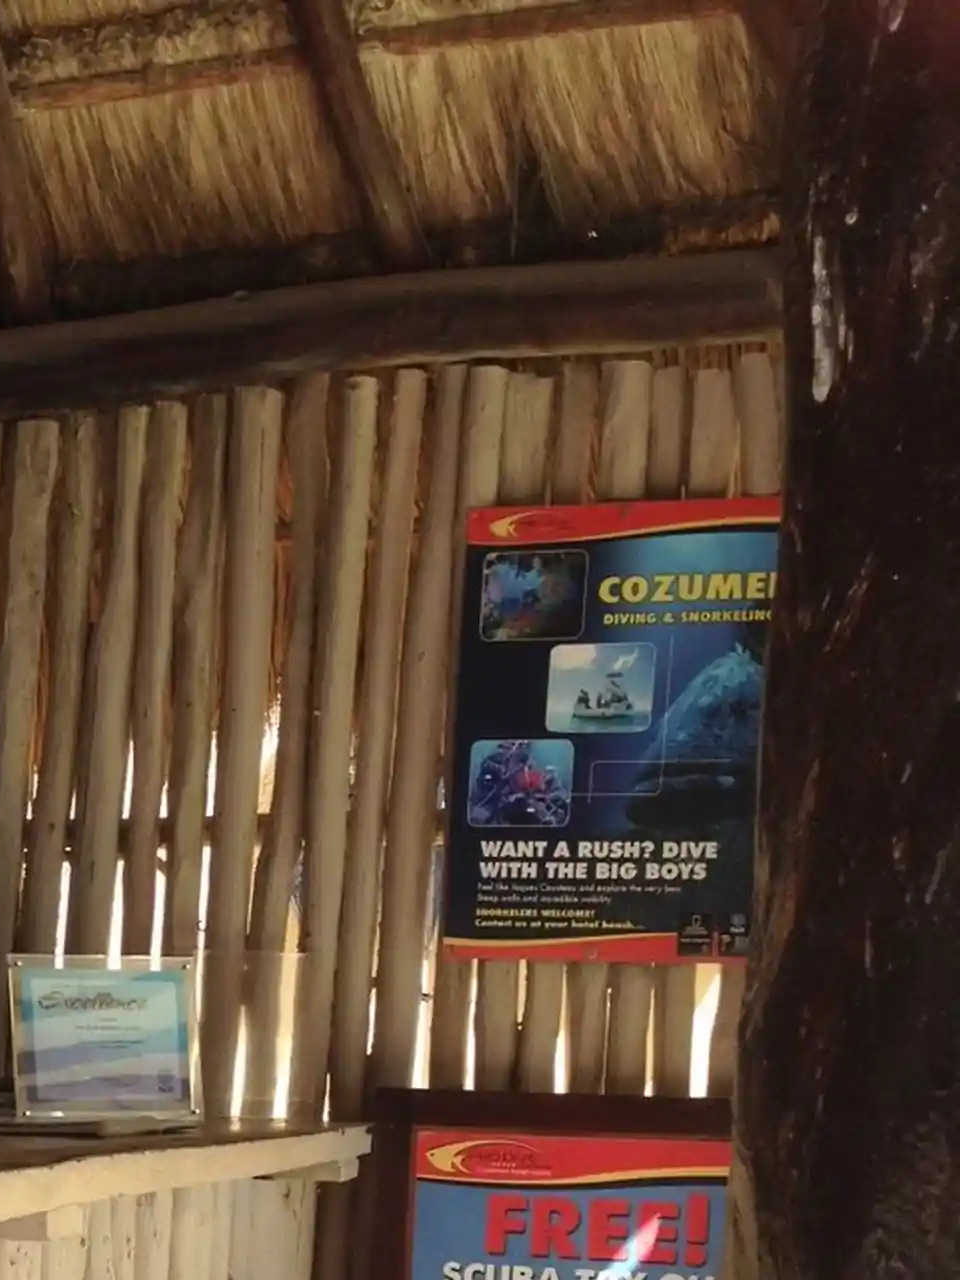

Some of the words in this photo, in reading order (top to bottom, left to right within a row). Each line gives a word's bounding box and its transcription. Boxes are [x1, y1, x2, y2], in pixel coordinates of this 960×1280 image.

[603, 611, 657, 625] DIVING
[662, 611, 676, 624] &
[480, 840, 548, 858] WANT
[553, 841, 571, 858] A
[578, 841, 656, 859] RUSH?
[662, 841, 718, 859] DIVE
[480, 861, 538, 879] WITH
[545, 861, 588, 879] THE
[595, 862, 638, 880] BIG
[645, 862, 707, 880] BOYS
[476, 908, 538, 917] SNORKELERS
[475, 919, 512, 927] Contact
[484, 1192, 711, 1268] FREE!
